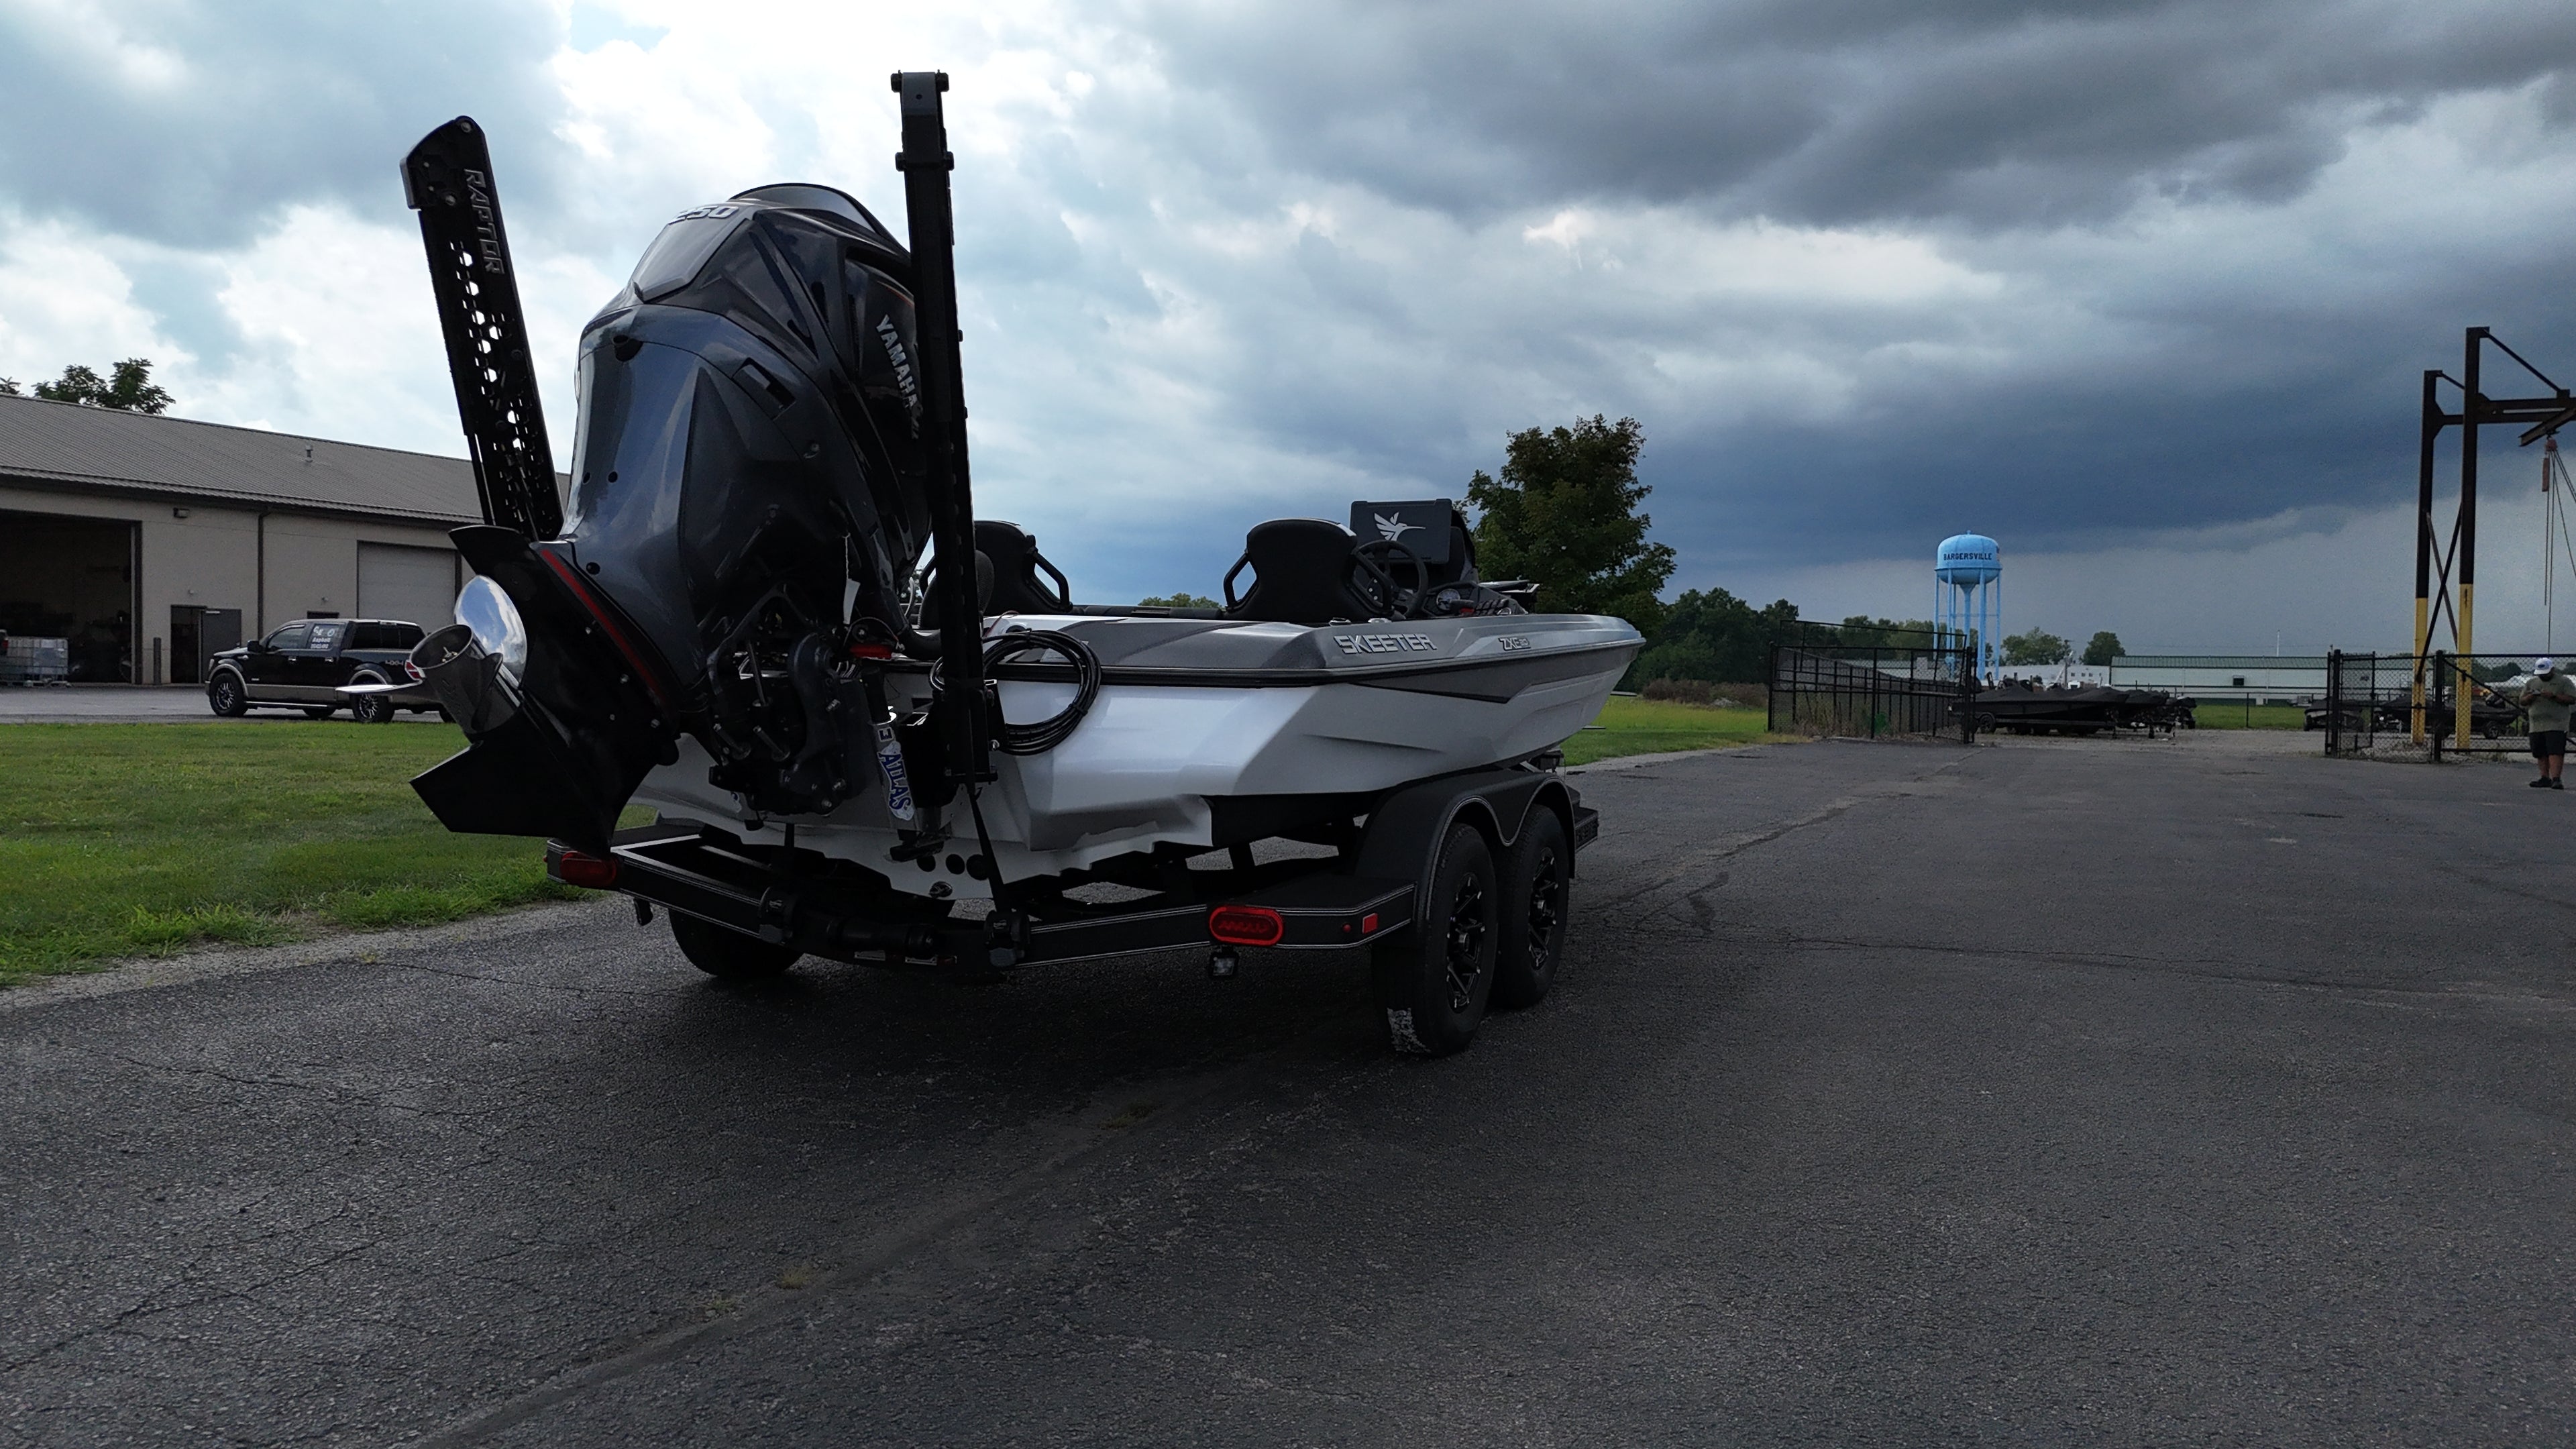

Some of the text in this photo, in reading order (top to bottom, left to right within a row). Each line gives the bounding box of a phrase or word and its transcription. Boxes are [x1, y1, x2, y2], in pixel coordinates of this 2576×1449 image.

[464, 168, 505, 274] RAPTOR
[669, 205, 739, 224] 250
[875, 313, 918, 409] YAMAHA
[1943, 552, 1992, 561] BARGERSVILLE
[1334, 633, 1437, 654] SKEETER
[877, 753, 912, 810] ATLAS
